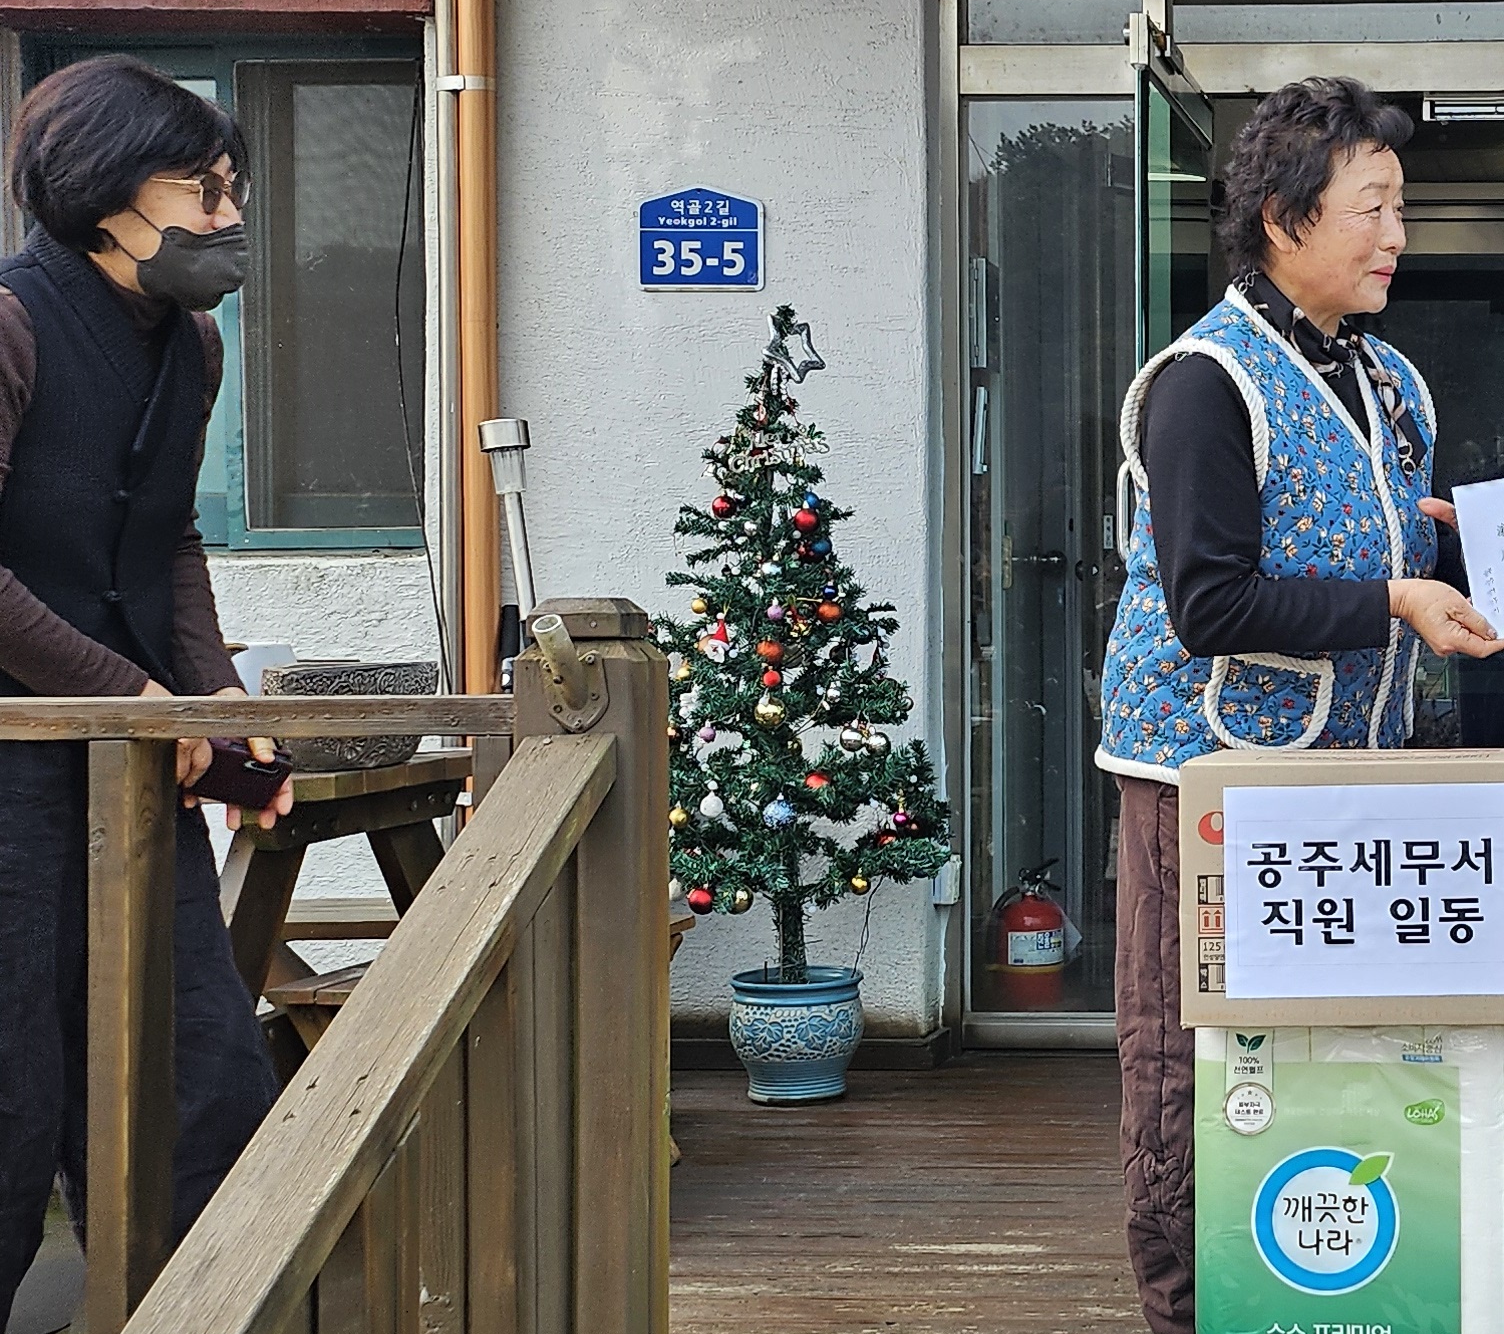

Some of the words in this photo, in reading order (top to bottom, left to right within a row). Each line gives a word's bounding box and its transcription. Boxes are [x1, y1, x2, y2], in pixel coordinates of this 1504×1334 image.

[670, 199, 730, 216] 역골2길
[658, 216, 707, 228] Yeokgol
[710, 216, 737, 228] 2-gil
[652, 240, 745, 276] 35-5
[1247, 837, 1493, 889] 공주세무서
[1261, 898, 1355, 946] 직원
[1389, 897, 1484, 944] 일동
[1203, 942, 1222, 952] 125
[1238, 1056, 1260, 1064] 100%
[1407, 1105, 1440, 1121] LOHAS
[1283, 1193, 1369, 1224] 깨끗한
[1298, 1229, 1353, 1256] 나라
